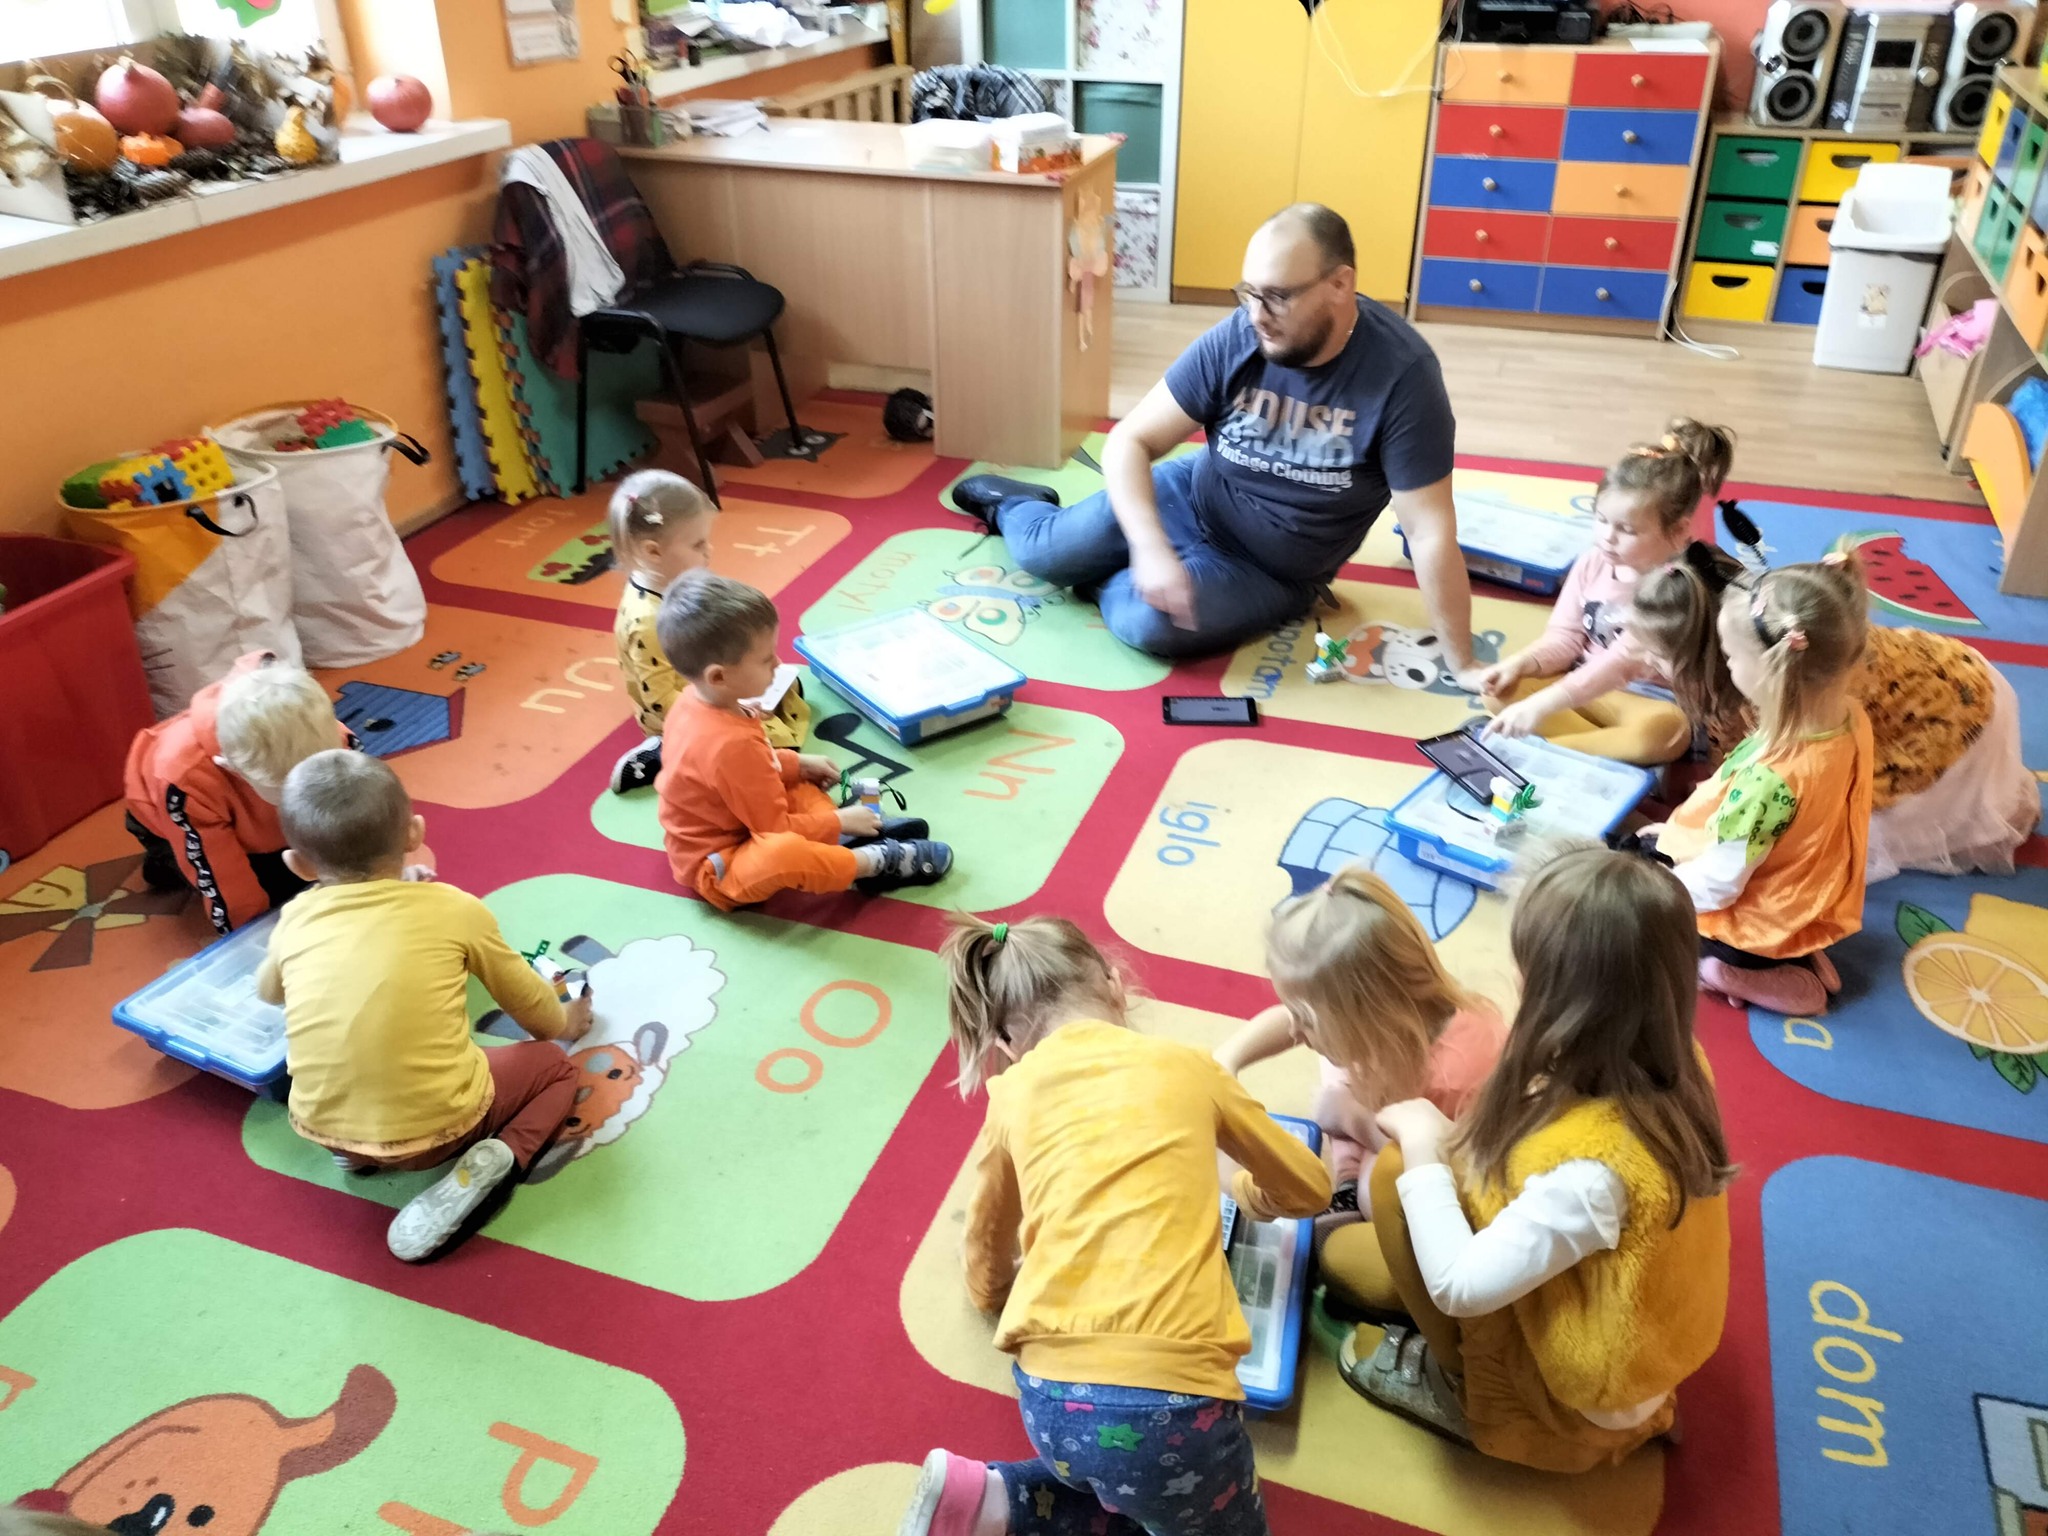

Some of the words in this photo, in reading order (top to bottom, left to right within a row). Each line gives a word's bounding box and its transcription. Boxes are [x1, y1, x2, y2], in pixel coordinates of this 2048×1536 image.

[1216, 434, 1271, 473] Vintage
[1271, 461, 1354, 489] Clothing
[1243, 620, 1303, 699] potam
[1157, 801, 1232, 867] iglo
[1808, 1280, 1904, 1468] dom
